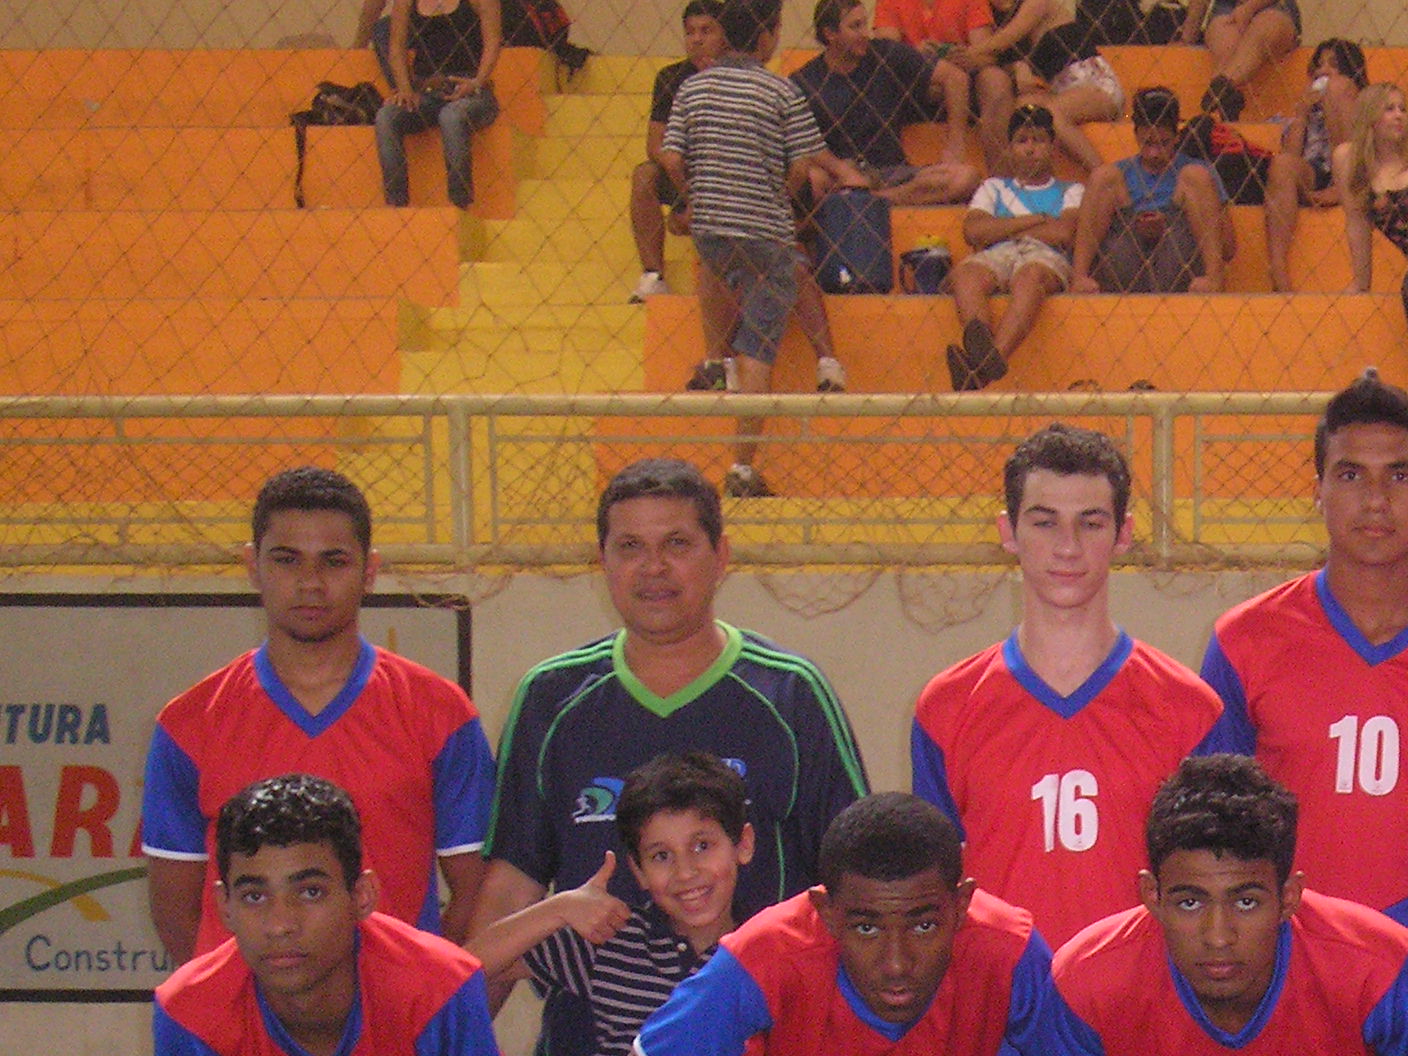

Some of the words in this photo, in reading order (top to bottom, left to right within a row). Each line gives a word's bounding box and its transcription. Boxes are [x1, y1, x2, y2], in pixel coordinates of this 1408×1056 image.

[0, 703, 111, 745] TURA
[1329, 715, 1400, 796] 10
[1031, 769, 1099, 853] 16
